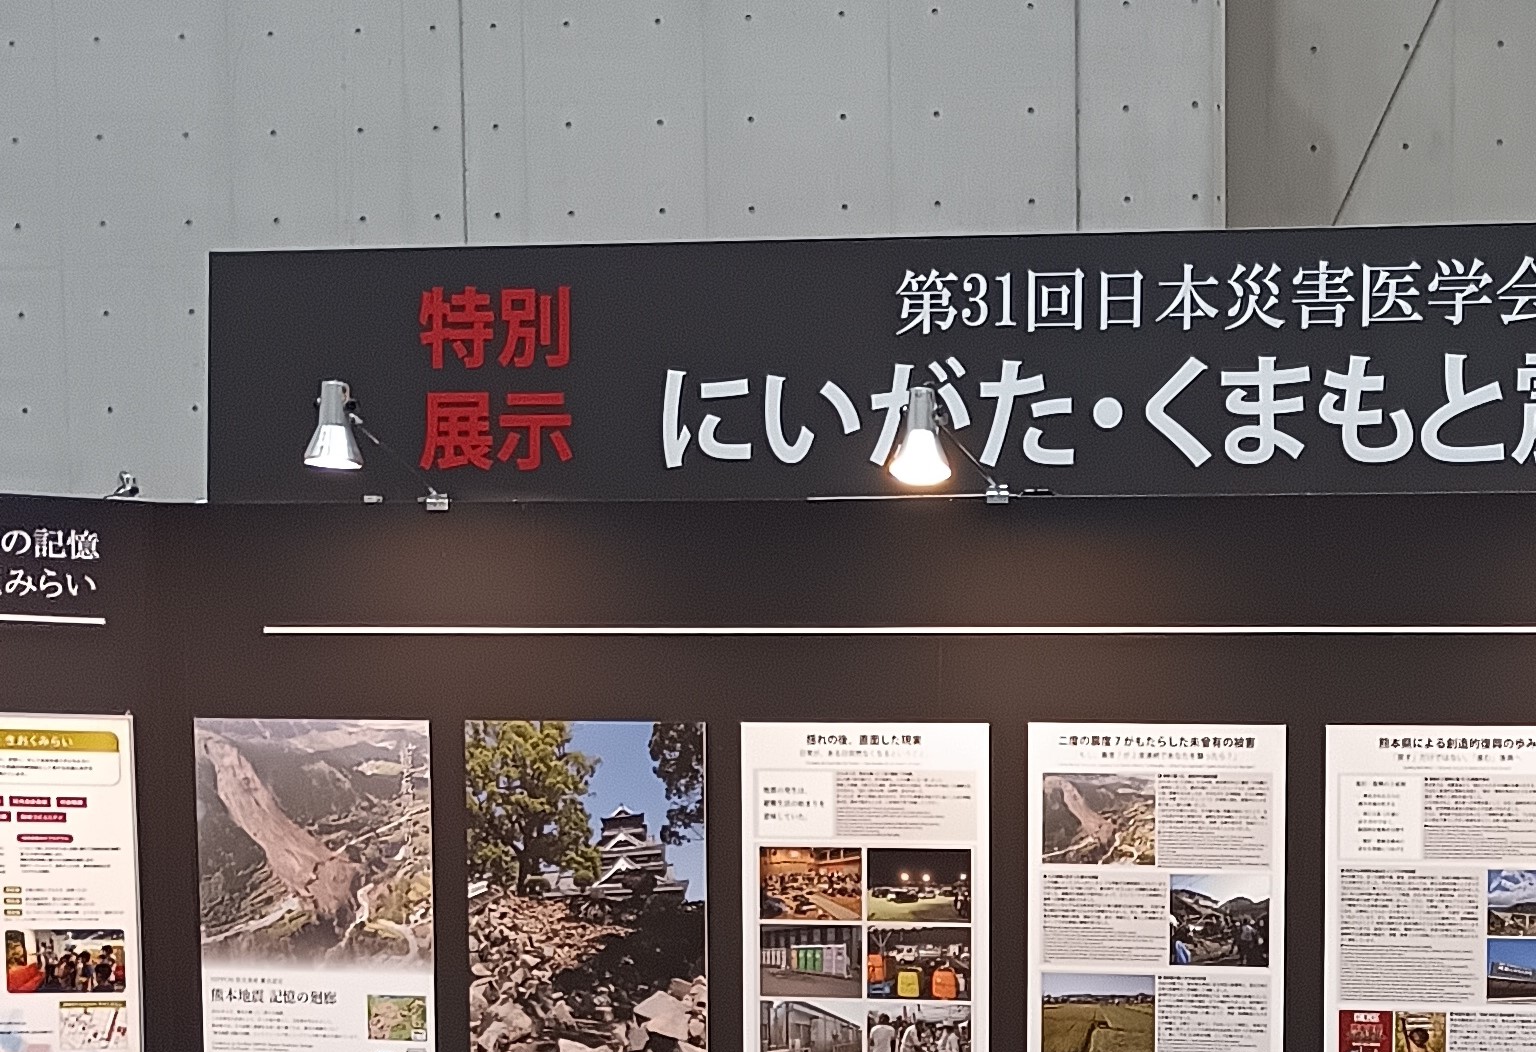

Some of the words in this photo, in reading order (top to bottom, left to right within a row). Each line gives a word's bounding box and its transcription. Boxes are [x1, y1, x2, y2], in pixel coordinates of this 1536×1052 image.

[418, 285, 573, 371] 特別
[418, 391, 574, 472] 展示
[0, 527, 100, 560] の記憶
[0, 567, 97, 599] みらい
